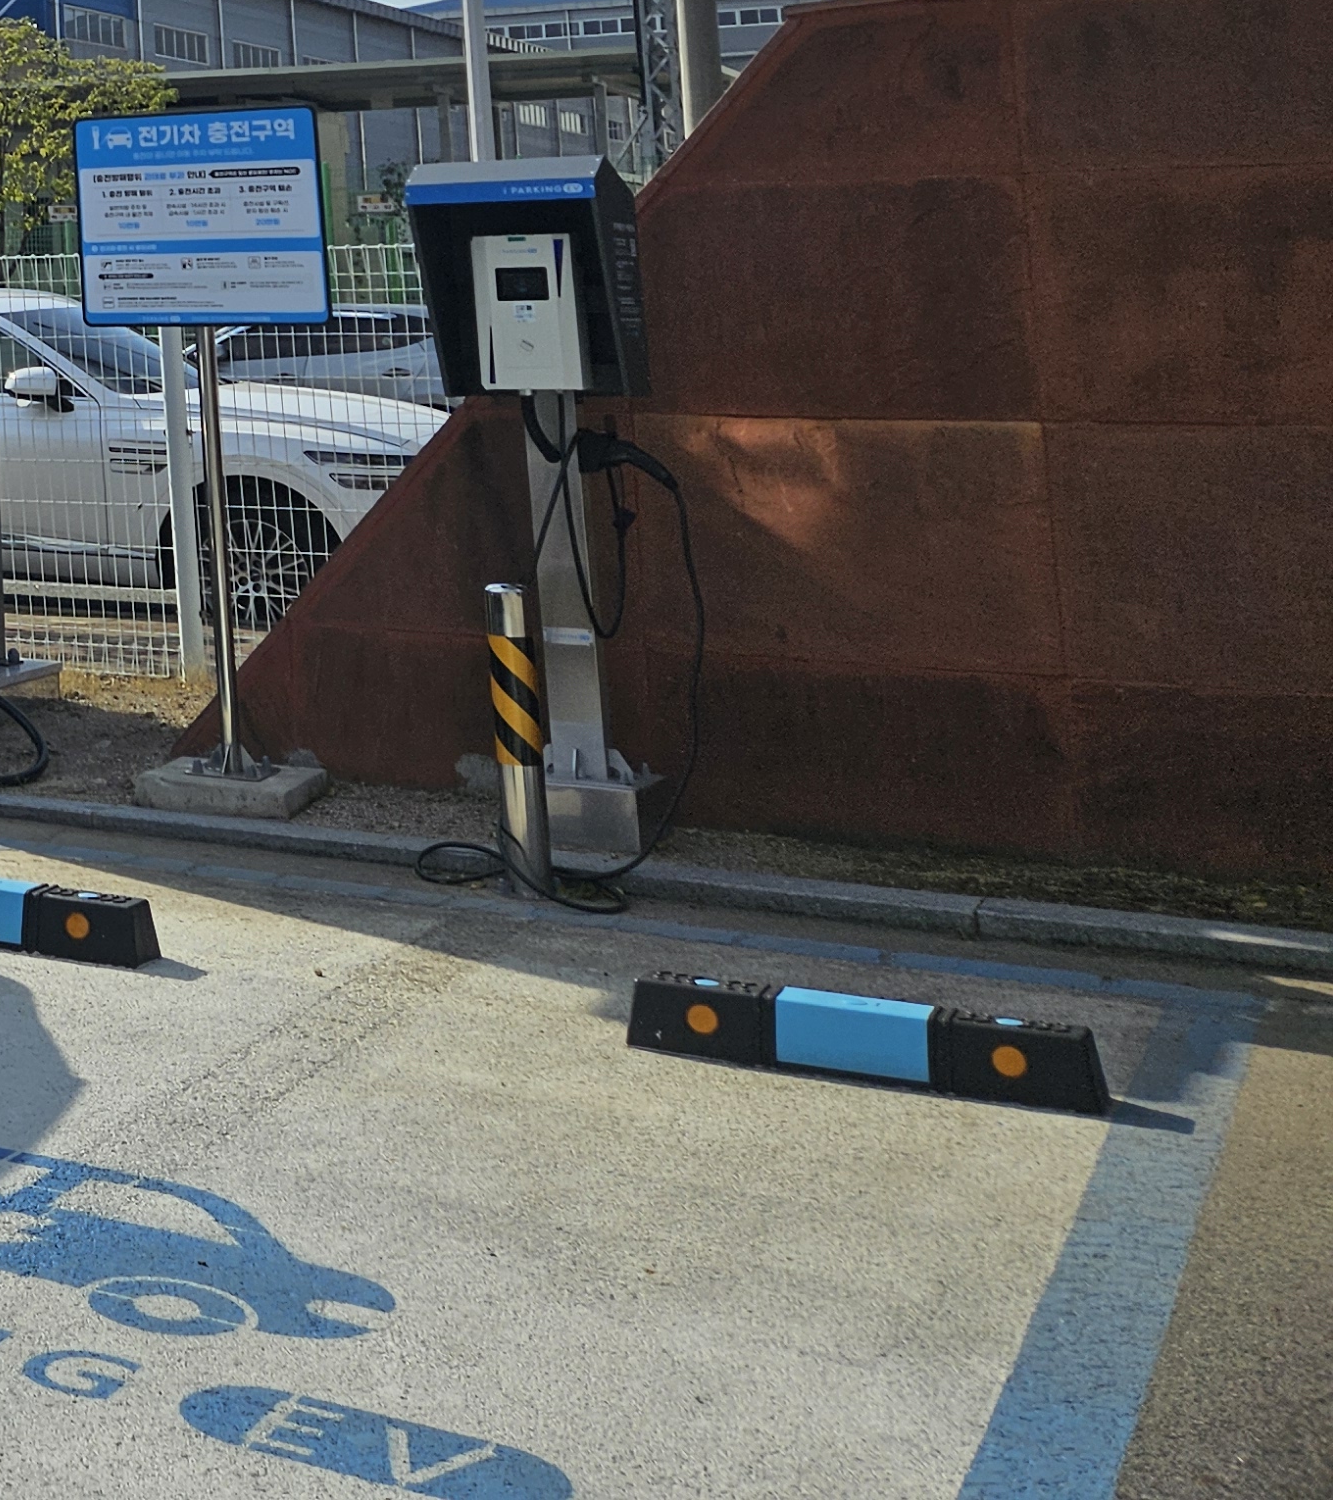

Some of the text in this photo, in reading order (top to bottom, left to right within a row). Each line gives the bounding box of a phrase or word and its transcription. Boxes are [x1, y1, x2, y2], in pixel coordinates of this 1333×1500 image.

[137, 118, 295, 147] 전기차 충전구역
[510, 184, 562, 194] PARKING
[241, 1393, 499, 1484] EV
